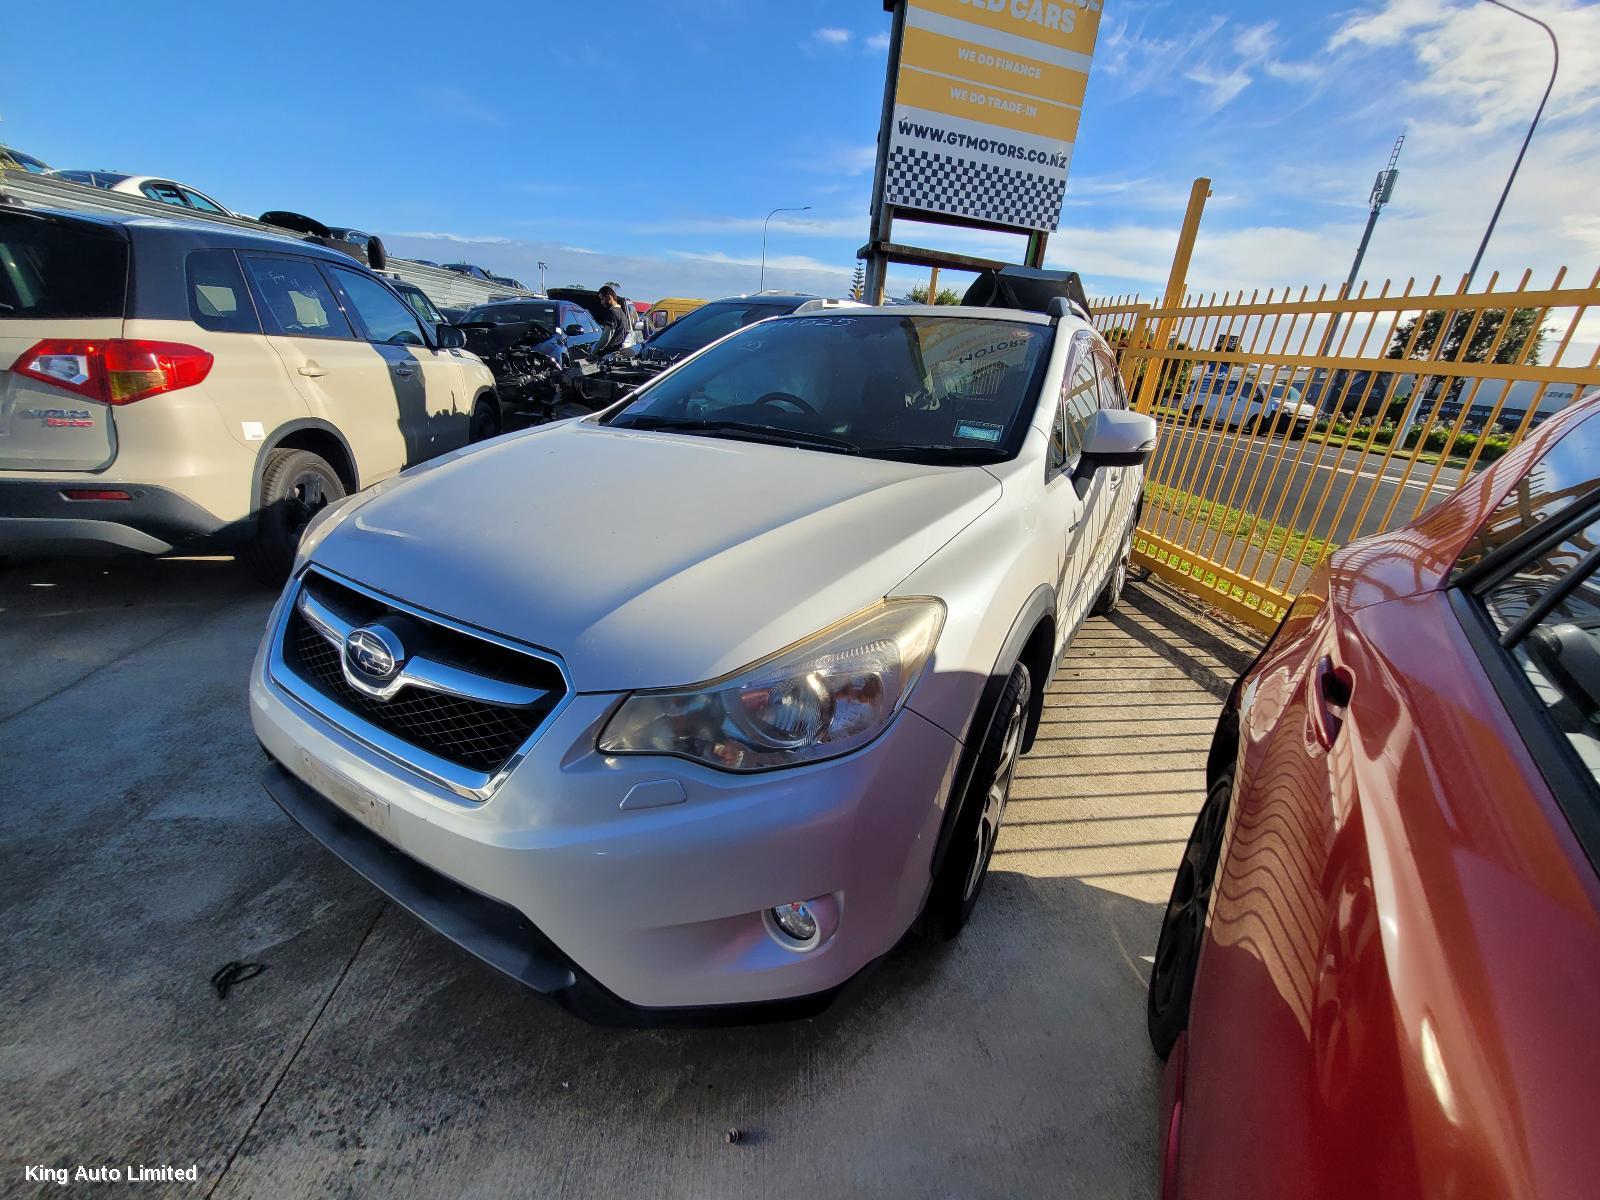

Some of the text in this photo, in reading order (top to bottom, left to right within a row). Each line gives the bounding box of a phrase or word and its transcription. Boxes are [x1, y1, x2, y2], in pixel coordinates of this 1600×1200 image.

[1010, 0, 1075, 33] CARS
[958, 48, 1041, 79] WE DO FINANCE
[950, 88, 1038, 118] WE DO TRADE-IN
[898, 120, 1067, 169] WWW.GTMOTORS.CO.NZ
